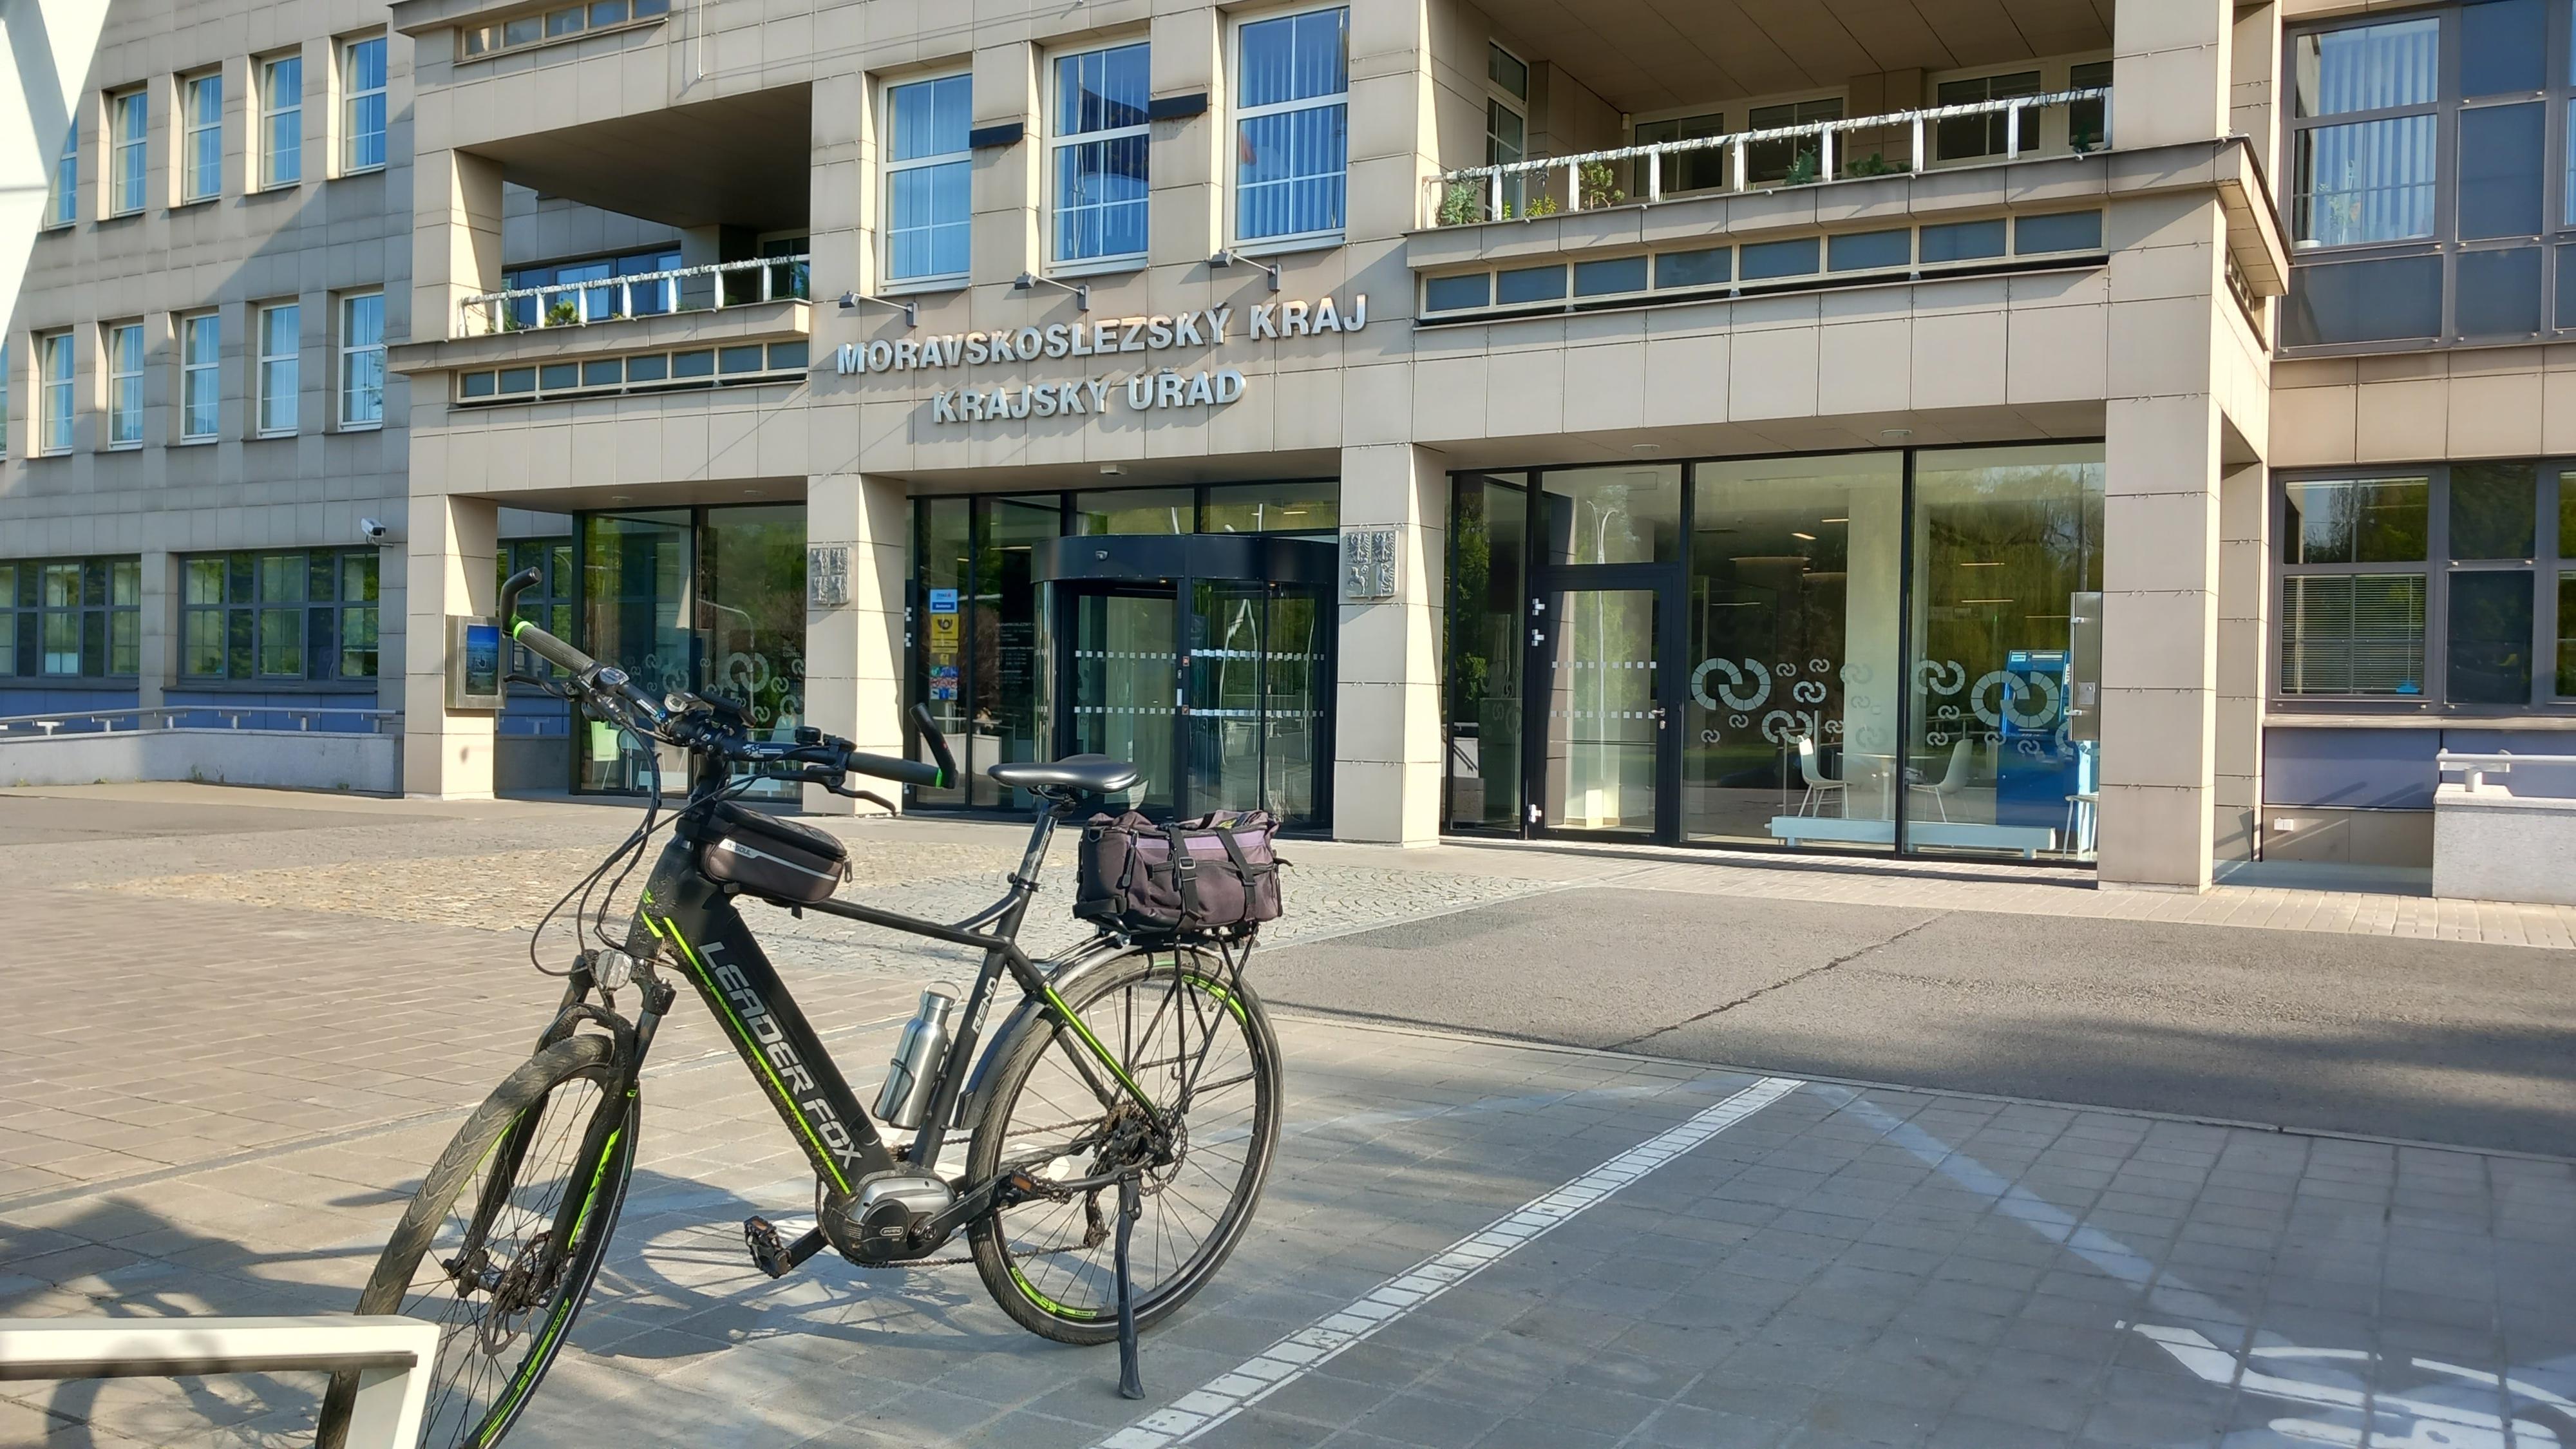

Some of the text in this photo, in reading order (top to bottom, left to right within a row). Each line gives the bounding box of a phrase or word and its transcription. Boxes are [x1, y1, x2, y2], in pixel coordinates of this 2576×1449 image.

[837, 294, 1368, 375] MORAVSKOSLEZSKÝ KRAJ
[697, 941, 863, 1170] LEADER FOX
